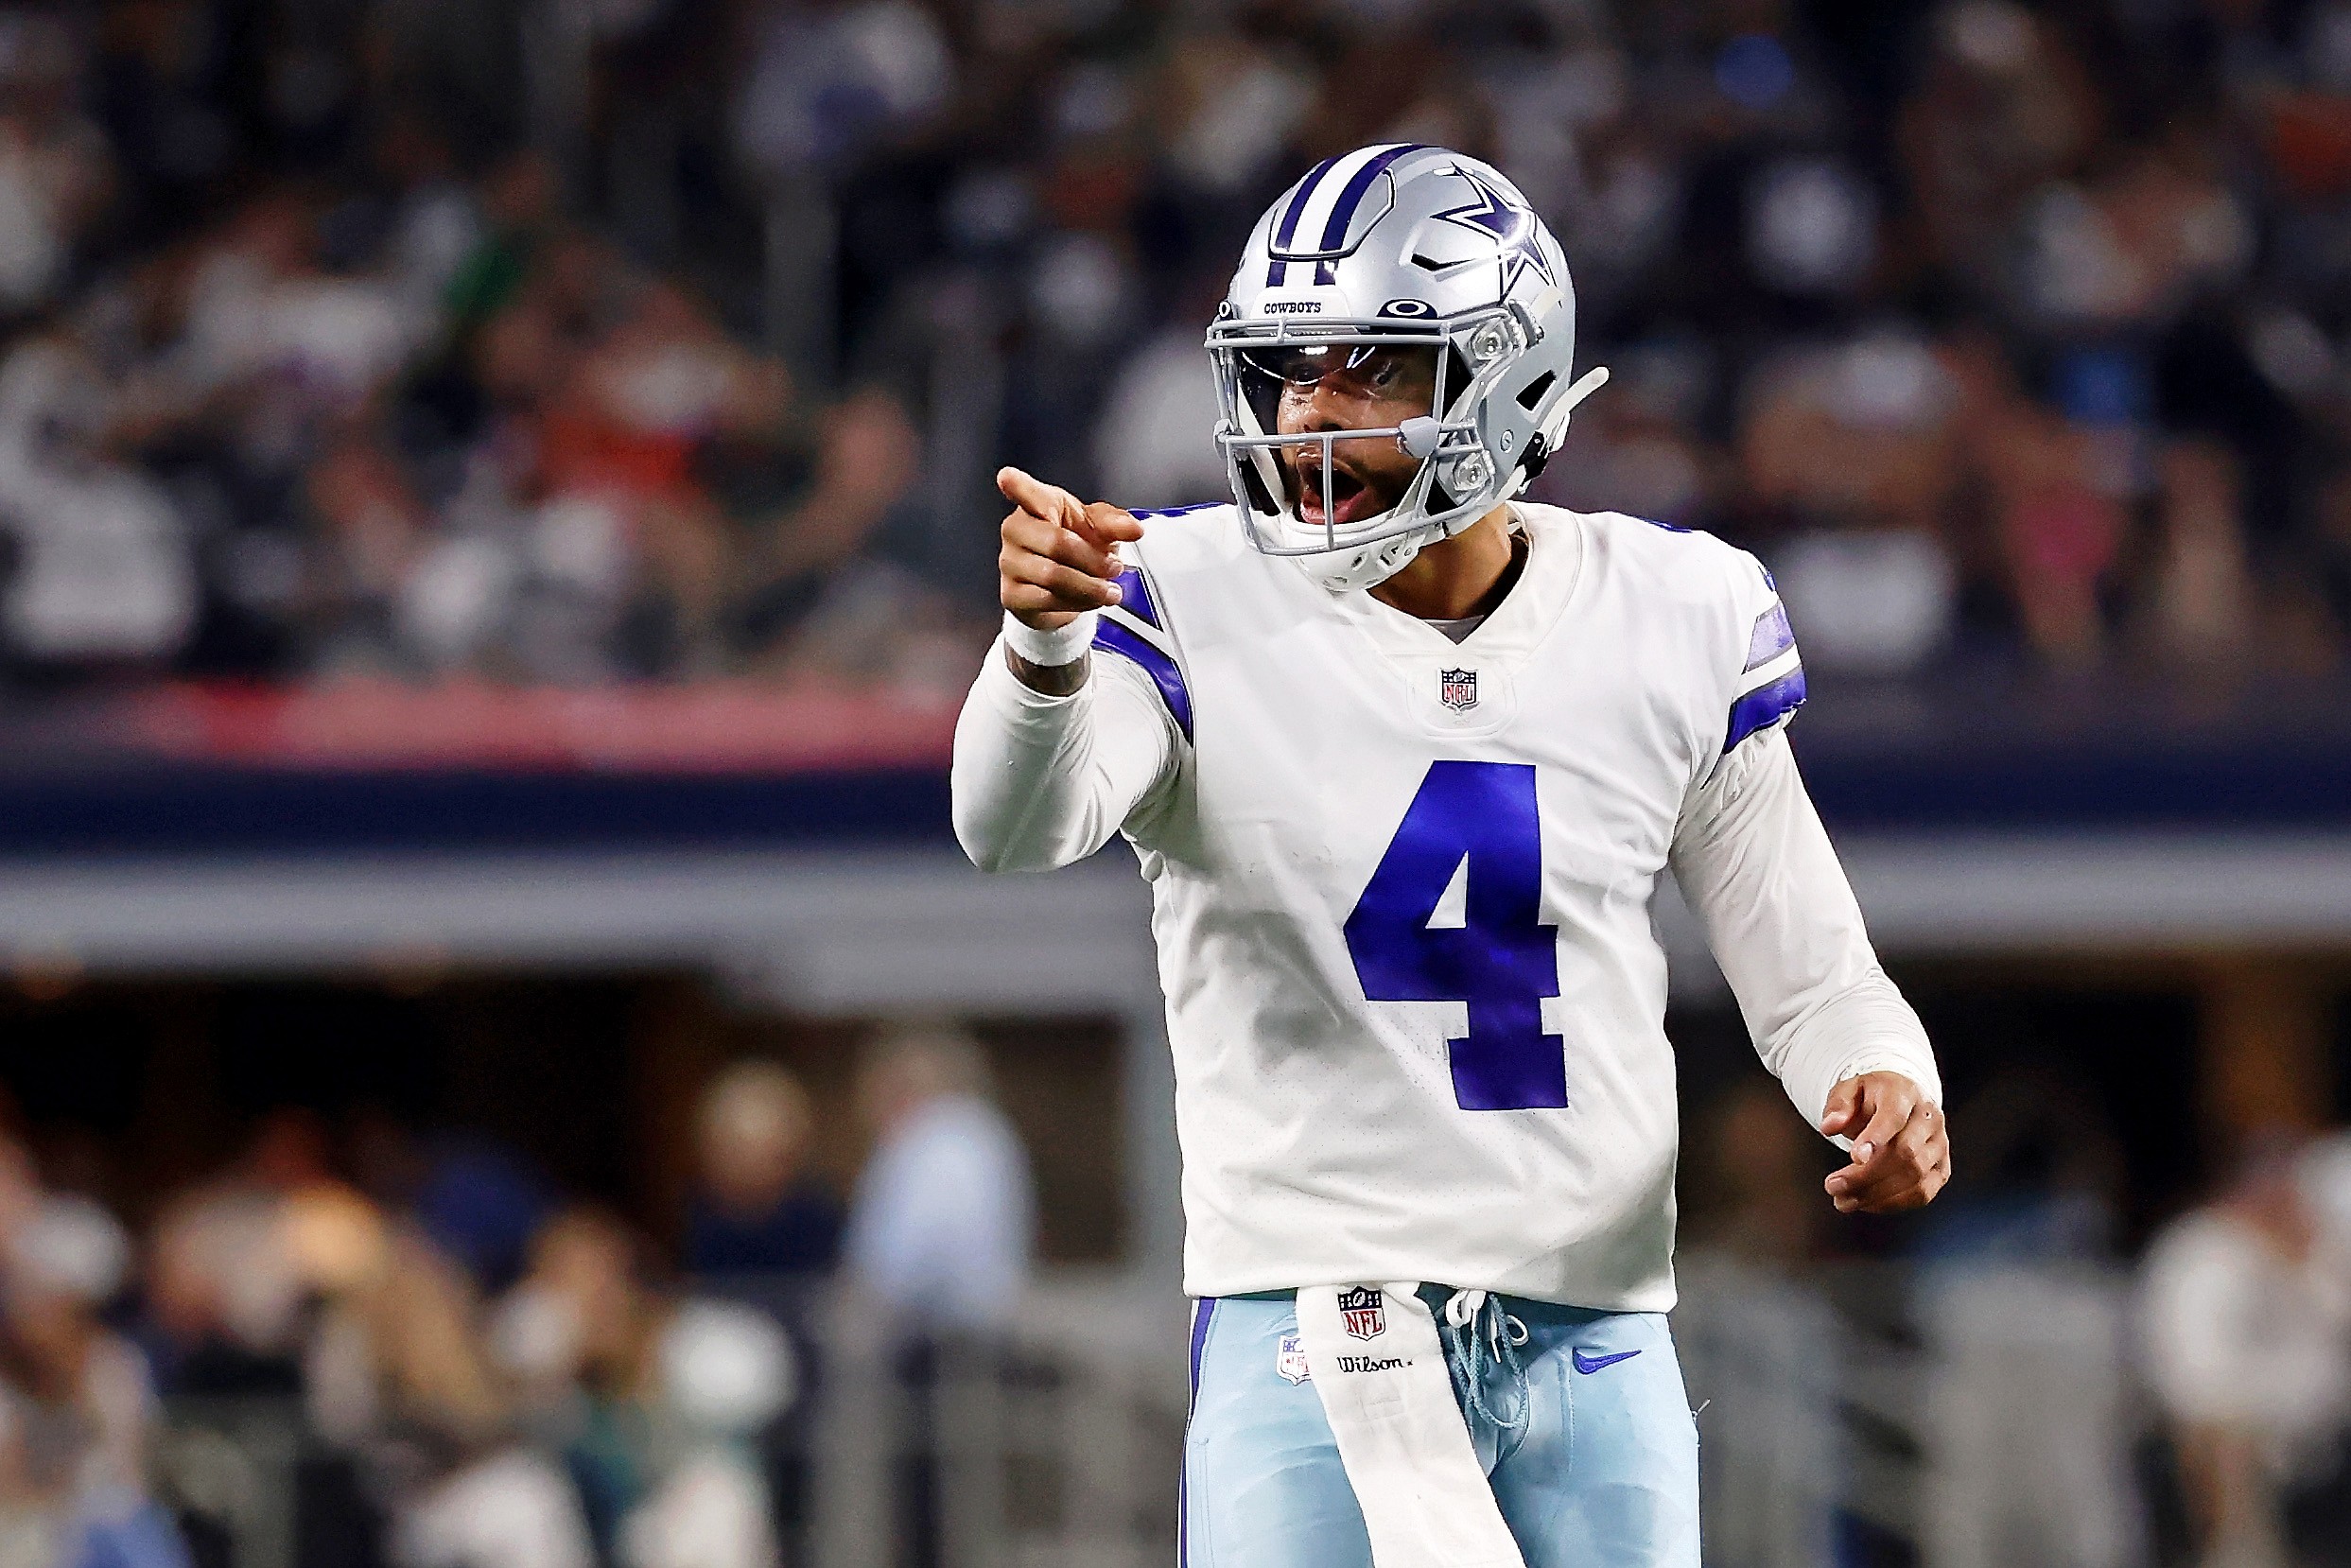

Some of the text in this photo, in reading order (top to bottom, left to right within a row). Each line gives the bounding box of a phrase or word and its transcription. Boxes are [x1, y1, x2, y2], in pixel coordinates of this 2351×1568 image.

[1263, 302, 1322, 314] COWBOYS
[1343, 759, 1568, 1110] 4
[1344, 1310, 1384, 1336] NFL
[1336, 1355, 1404, 1373] Wilson
